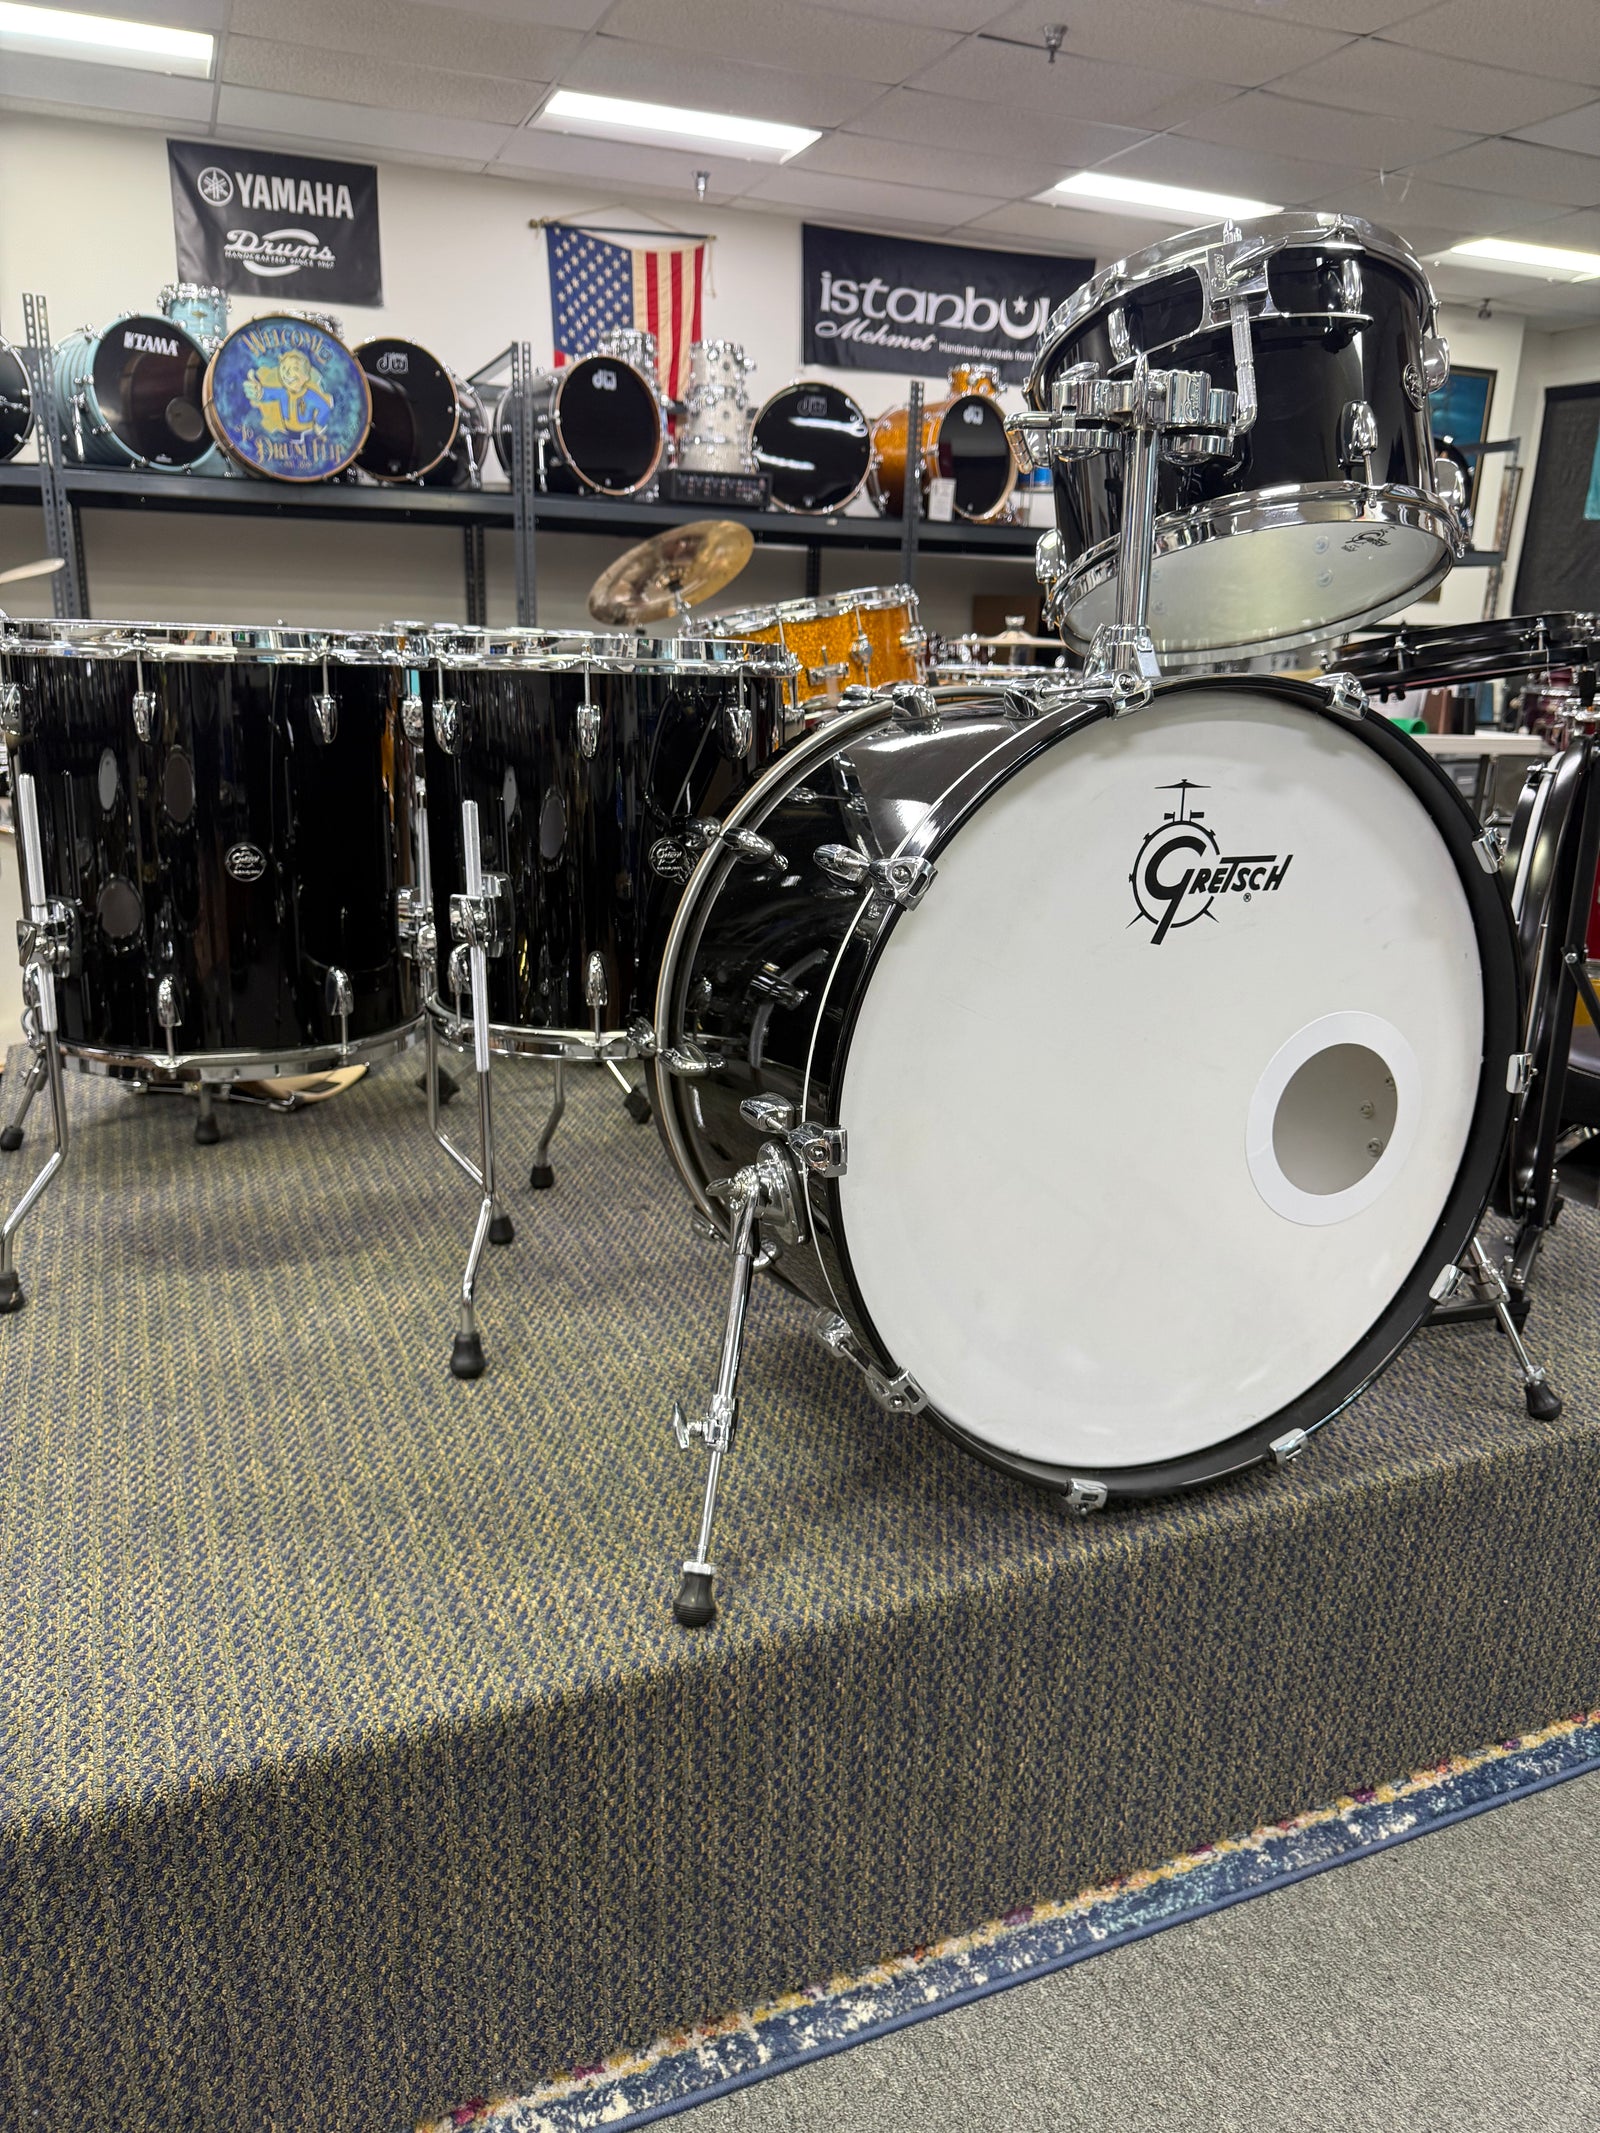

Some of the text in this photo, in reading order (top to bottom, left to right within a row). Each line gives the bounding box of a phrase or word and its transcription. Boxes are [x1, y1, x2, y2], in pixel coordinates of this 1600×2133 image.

[235, 171, 354, 220] YAMAHA
[224, 229, 336, 261] Drums
[134, 332, 178, 357] TAMA
[815, 317, 937, 352] Mehmet
[1145, 835, 1294, 945] GRETSCH
